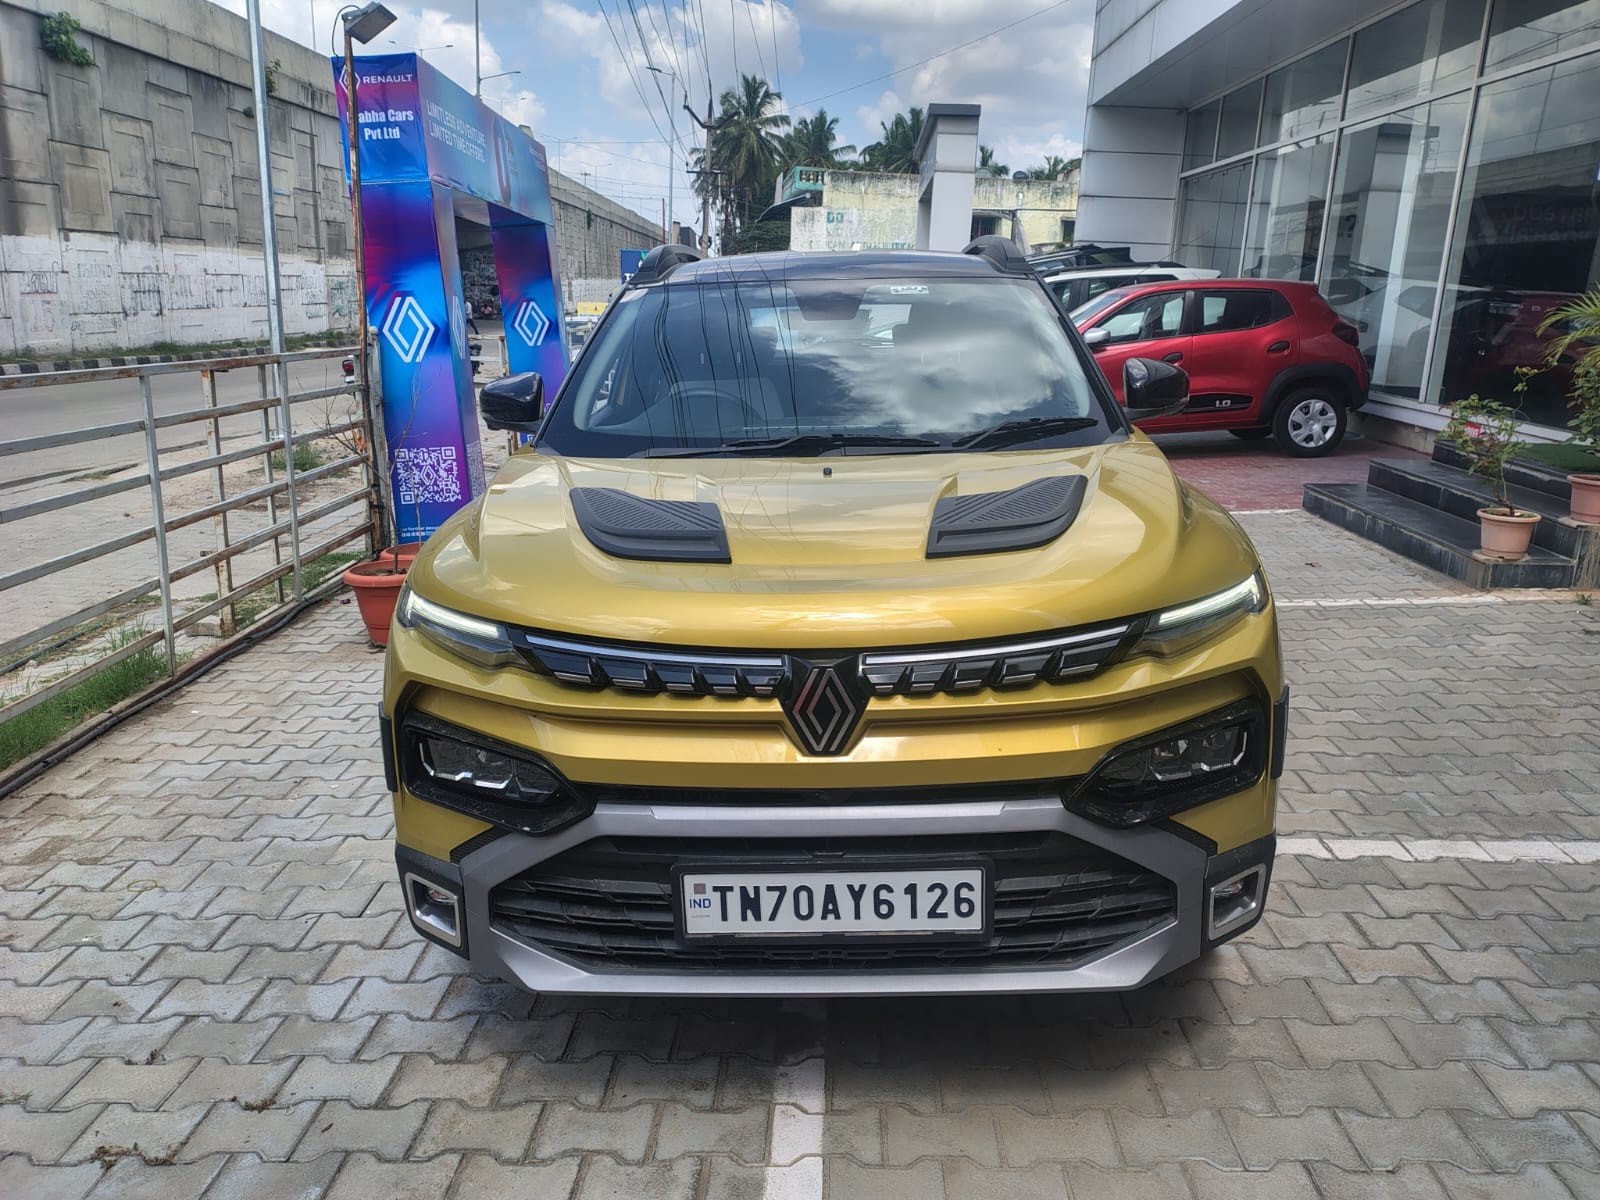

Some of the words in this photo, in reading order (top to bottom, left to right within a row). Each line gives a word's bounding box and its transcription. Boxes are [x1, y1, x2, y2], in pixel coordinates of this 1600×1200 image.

[363, 74, 412, 84] RENAULT
[387, 109, 414, 122] Cars
[364, 127, 382, 140] Pvt
[383, 126, 400, 139] Ltd
[689, 898, 711, 909] IND
[712, 882, 975, 922] TN70AY6126
